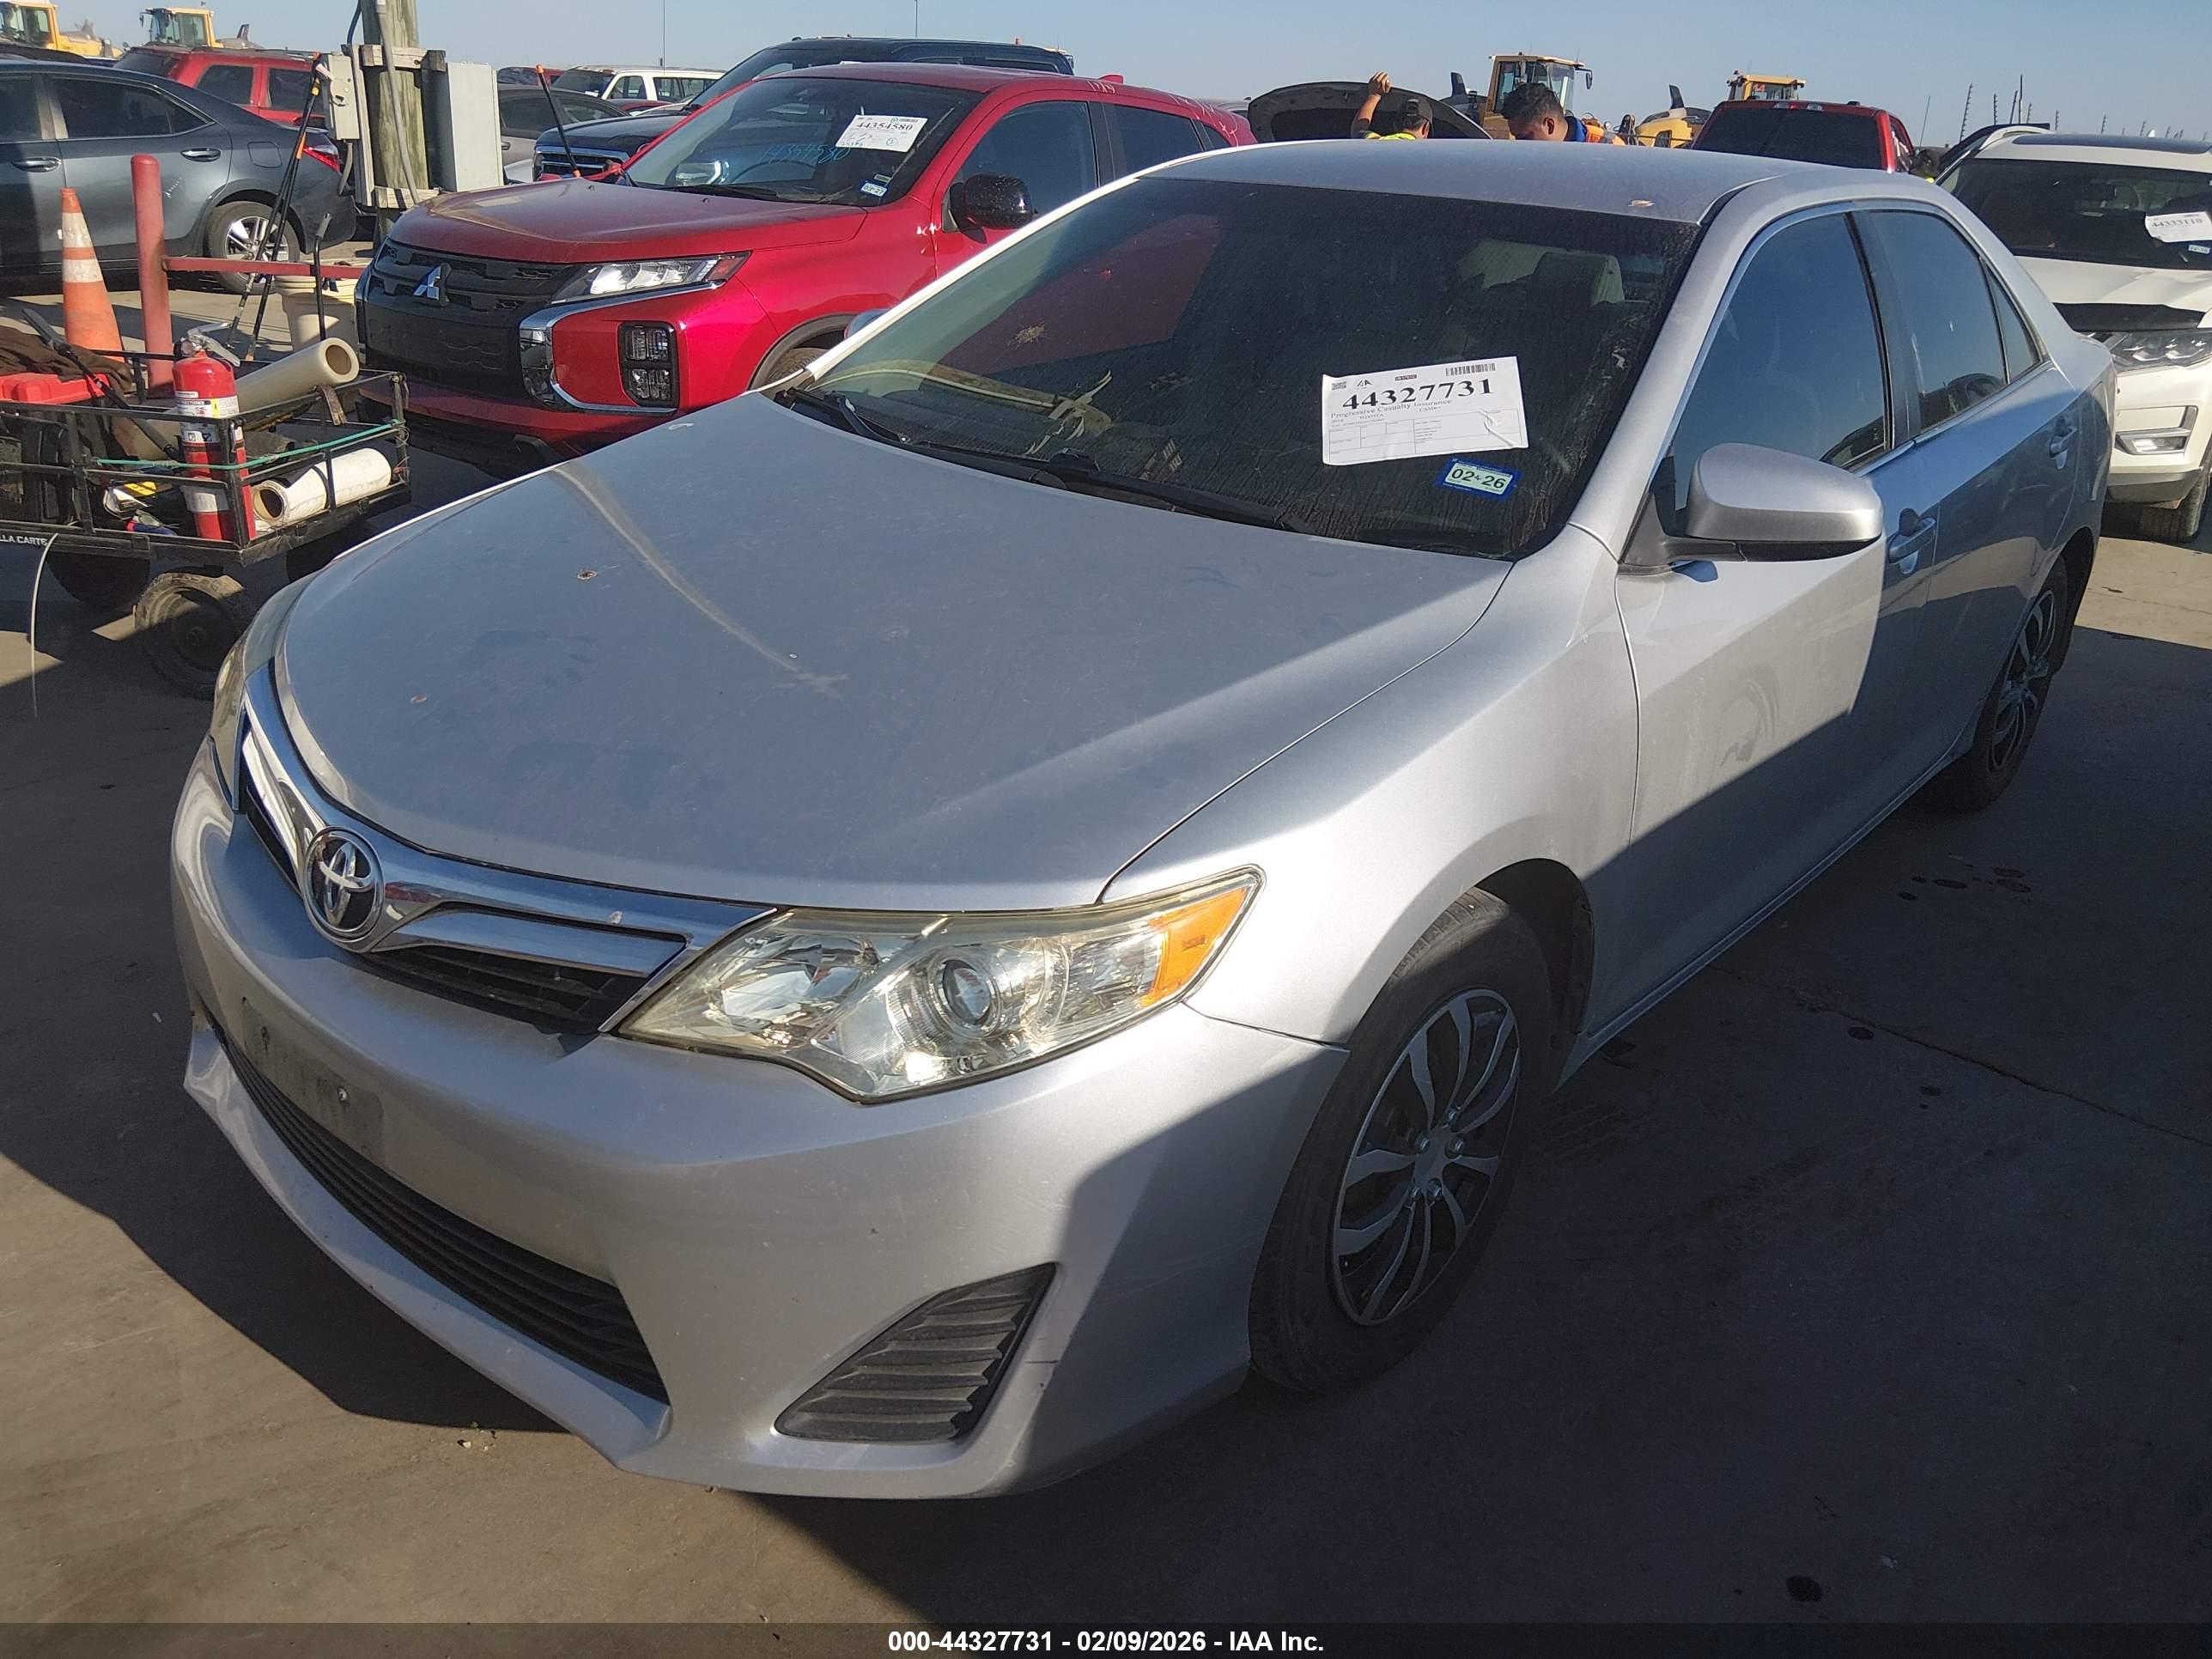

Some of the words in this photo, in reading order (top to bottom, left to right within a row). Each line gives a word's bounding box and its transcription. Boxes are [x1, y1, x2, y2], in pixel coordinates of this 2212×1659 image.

[856, 121, 913, 131] 44354580
[1342, 378, 1494, 410] 44327731
[1331, 408, 1375, 419] Progressive
[1377, 403, 1411, 412] Casualty
[1451, 468, 1475, 482] 02
[1481, 475, 1506, 489] 26
